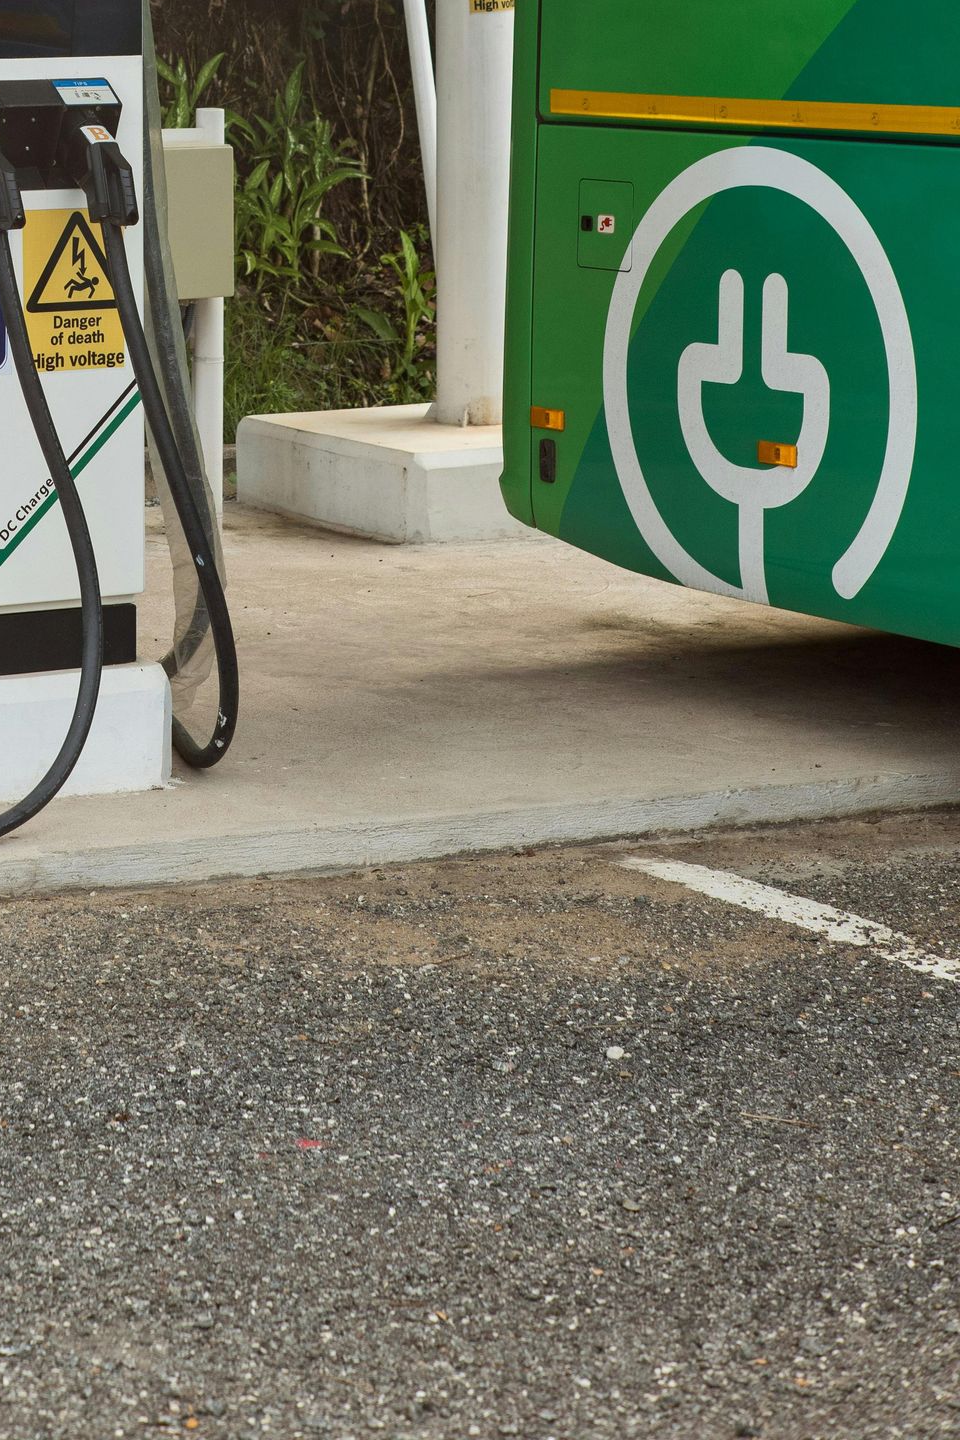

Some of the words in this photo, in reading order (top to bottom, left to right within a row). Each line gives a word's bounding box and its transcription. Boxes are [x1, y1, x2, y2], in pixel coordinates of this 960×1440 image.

[474, 0, 499, 12] High
[87, 127, 110, 141] B
[53, 315, 102, 330] Danger
[50, 332, 64, 345] of
[67, 330, 105, 344] death
[69, 350, 125, 368] voltage
